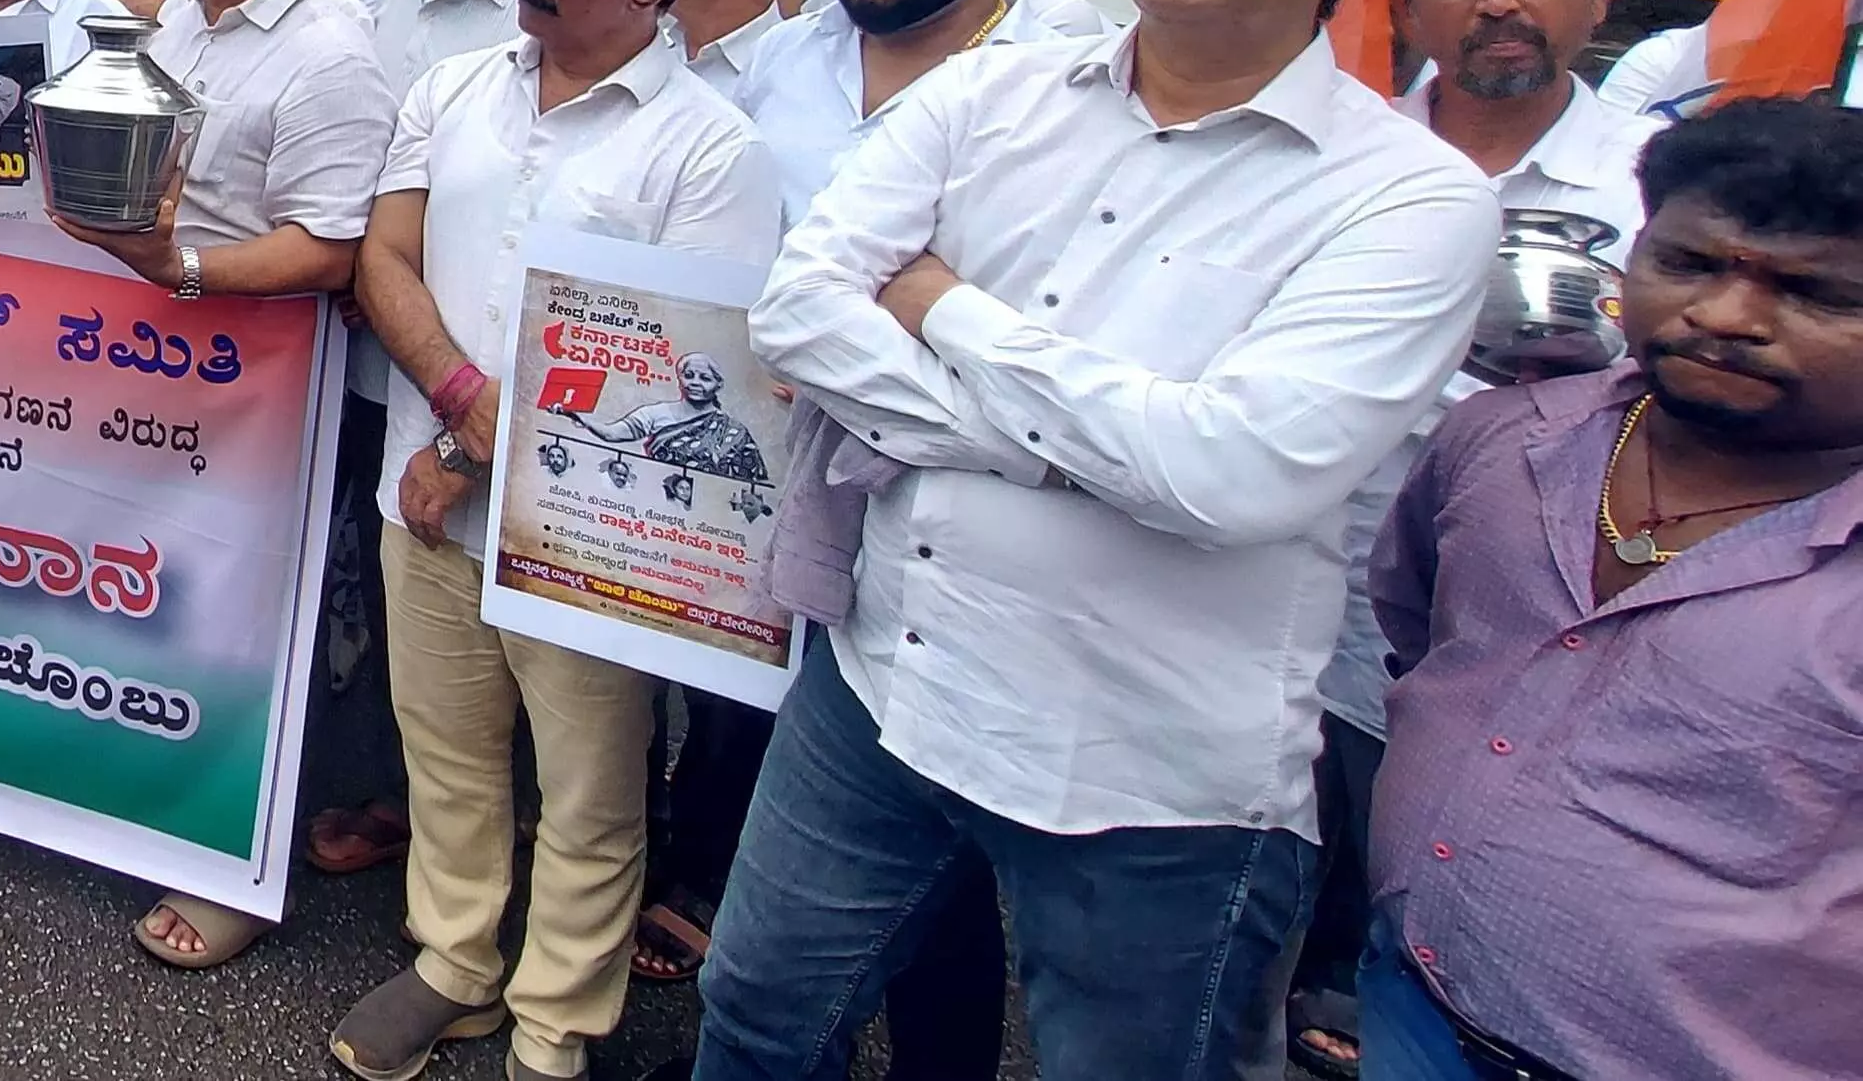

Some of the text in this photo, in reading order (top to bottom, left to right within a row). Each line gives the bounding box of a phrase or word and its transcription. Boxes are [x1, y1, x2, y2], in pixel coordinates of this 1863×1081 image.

[547, 300, 664, 340] ಕೇಂದ್ರ ಬಜೆಟ್ ನಲ್ಲಿ
[597, 294, 640, 317] ಏನಿಲ್ಲಾ
[58, 307, 244, 384] ಸಮಿತಿ
[567, 344, 672, 386] ಏನಿಲ್ಲಾ...
[570, 324, 674, 367] ಕರ್ನಾಟಕಕ್ಕೆ
[98, 408, 207, 476] ವಿರುದ್ಧ
[598, 513, 648, 541] ರಾಜ್ಯಕ್ಕೆ
[650, 525, 713, 552] ಏನೇನೂ
[554, 526, 748, 591] ಮೇಕೆದಾಟು ಯೋಜನೆಗೆ ಅನುಮತಿ ಇಲ್ಲ
[629, 563, 706, 595] ಅನುದಾನವಿಲ್ಲ
[510, 557, 551, 580] ಒಟ್ಟಿನಲ್ಲಿ
[551, 569, 587, 591] ರಾಜ್ಯಕ್ಕೆ
[687, 606, 719, 626] ಬಿಟ್ಟರೆ
